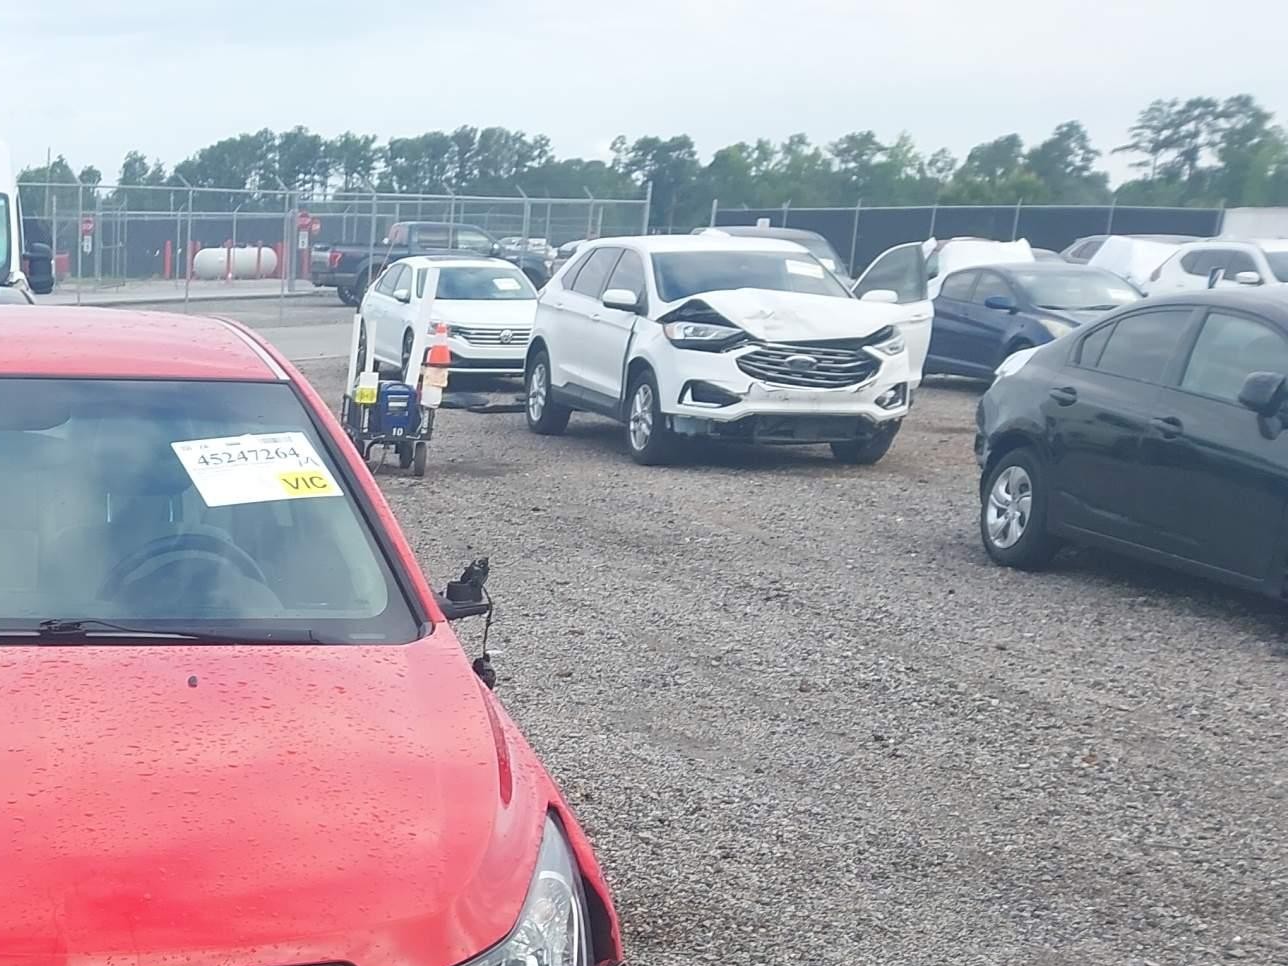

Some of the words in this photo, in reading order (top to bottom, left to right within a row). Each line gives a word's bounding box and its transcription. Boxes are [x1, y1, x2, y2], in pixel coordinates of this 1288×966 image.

[391, 427, 404, 437] 10
[197, 446, 300, 467] 45247264
[281, 475, 328, 491] VIC
